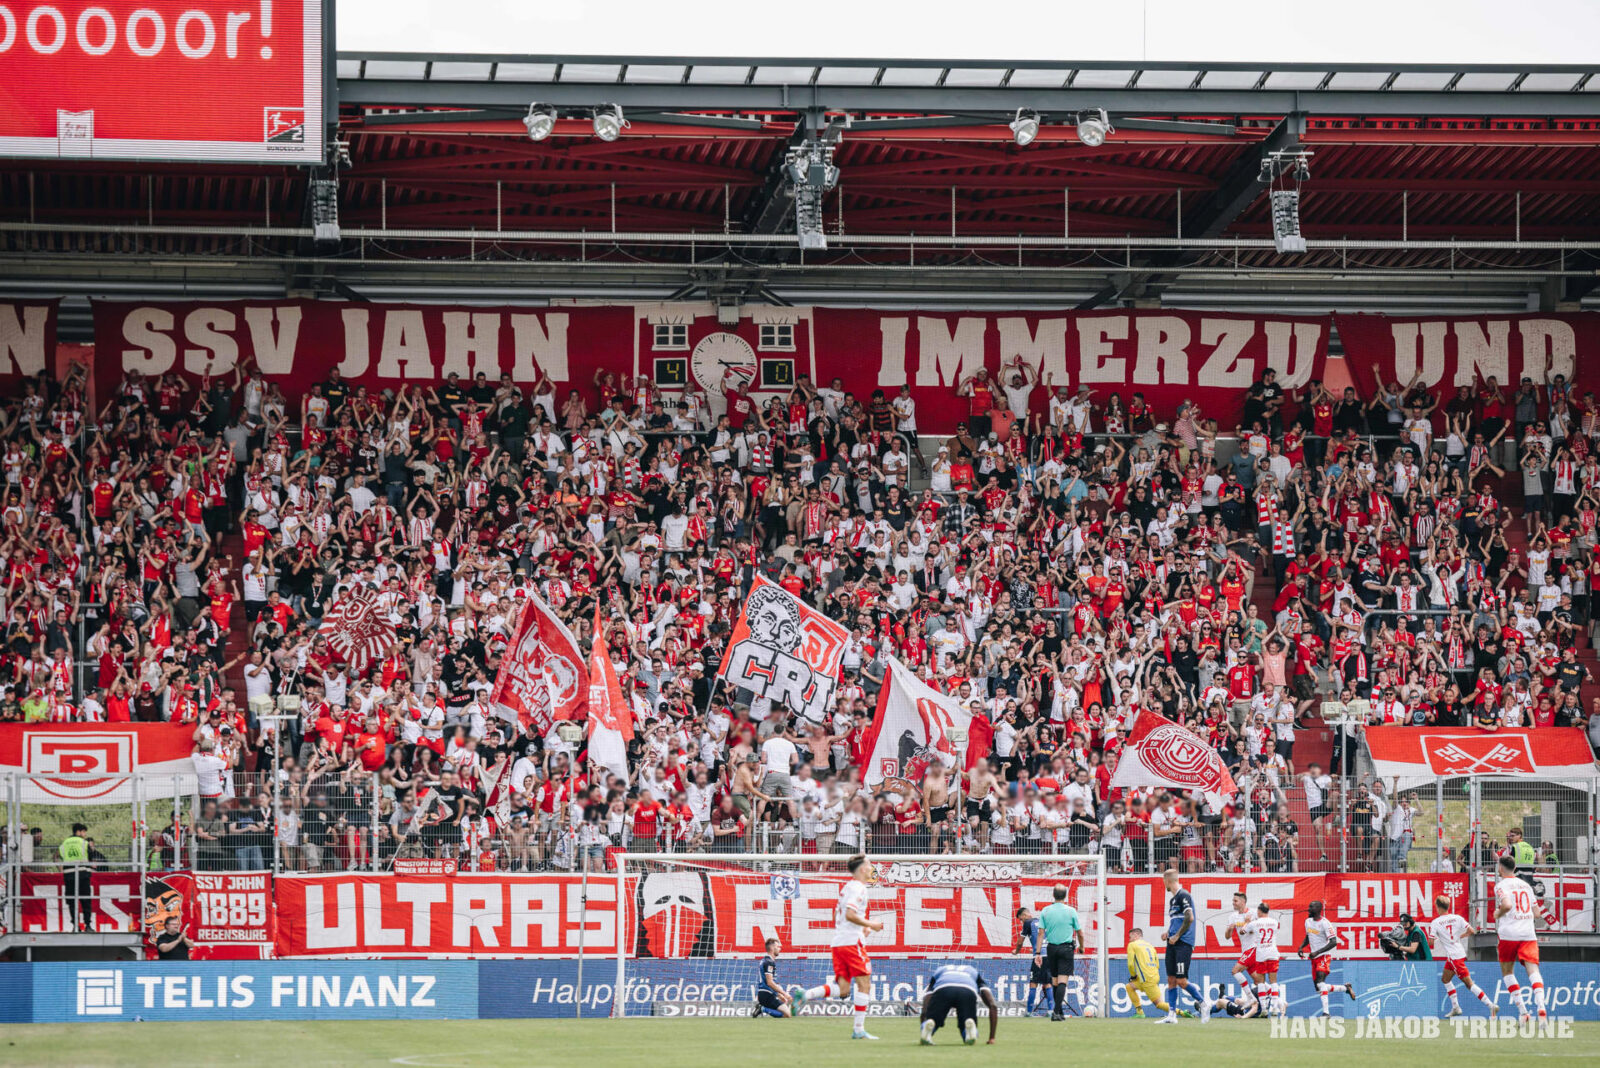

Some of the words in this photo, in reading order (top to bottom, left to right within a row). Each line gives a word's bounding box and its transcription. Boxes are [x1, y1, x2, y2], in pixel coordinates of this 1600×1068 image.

[122, 306, 301, 376] SSV
[337, 308, 570, 382] JAHN
[877, 315, 1321, 389] IMMERZU
[1391, 319, 1576, 389] UND
[667, 363, 679, 380] 4
[776, 363, 788, 382] 0
[1203, 768, 1215, 780] 89
[196, 876, 222, 890] SSV
[228, 876, 265, 890] JAHN
[887, 862, 926, 883] RED
[927, 862, 1022, 883] GENERATION
[197, 892, 266, 926] 1889
[1337, 880, 1433, 918] JAHN
[1512, 891, 1530, 914] 10
[305, 883, 617, 948] ULTRAS
[198, 929, 267, 940] REGENSBURG
[1259, 928, 1274, 944] 22
[1446, 925, 1454, 940] 7
[1176, 962, 1185, 974] 11
[136, 975, 255, 1008] TELIS
[271, 975, 436, 1008] FINANZ
[533, 977, 742, 1009] Haupförderer
